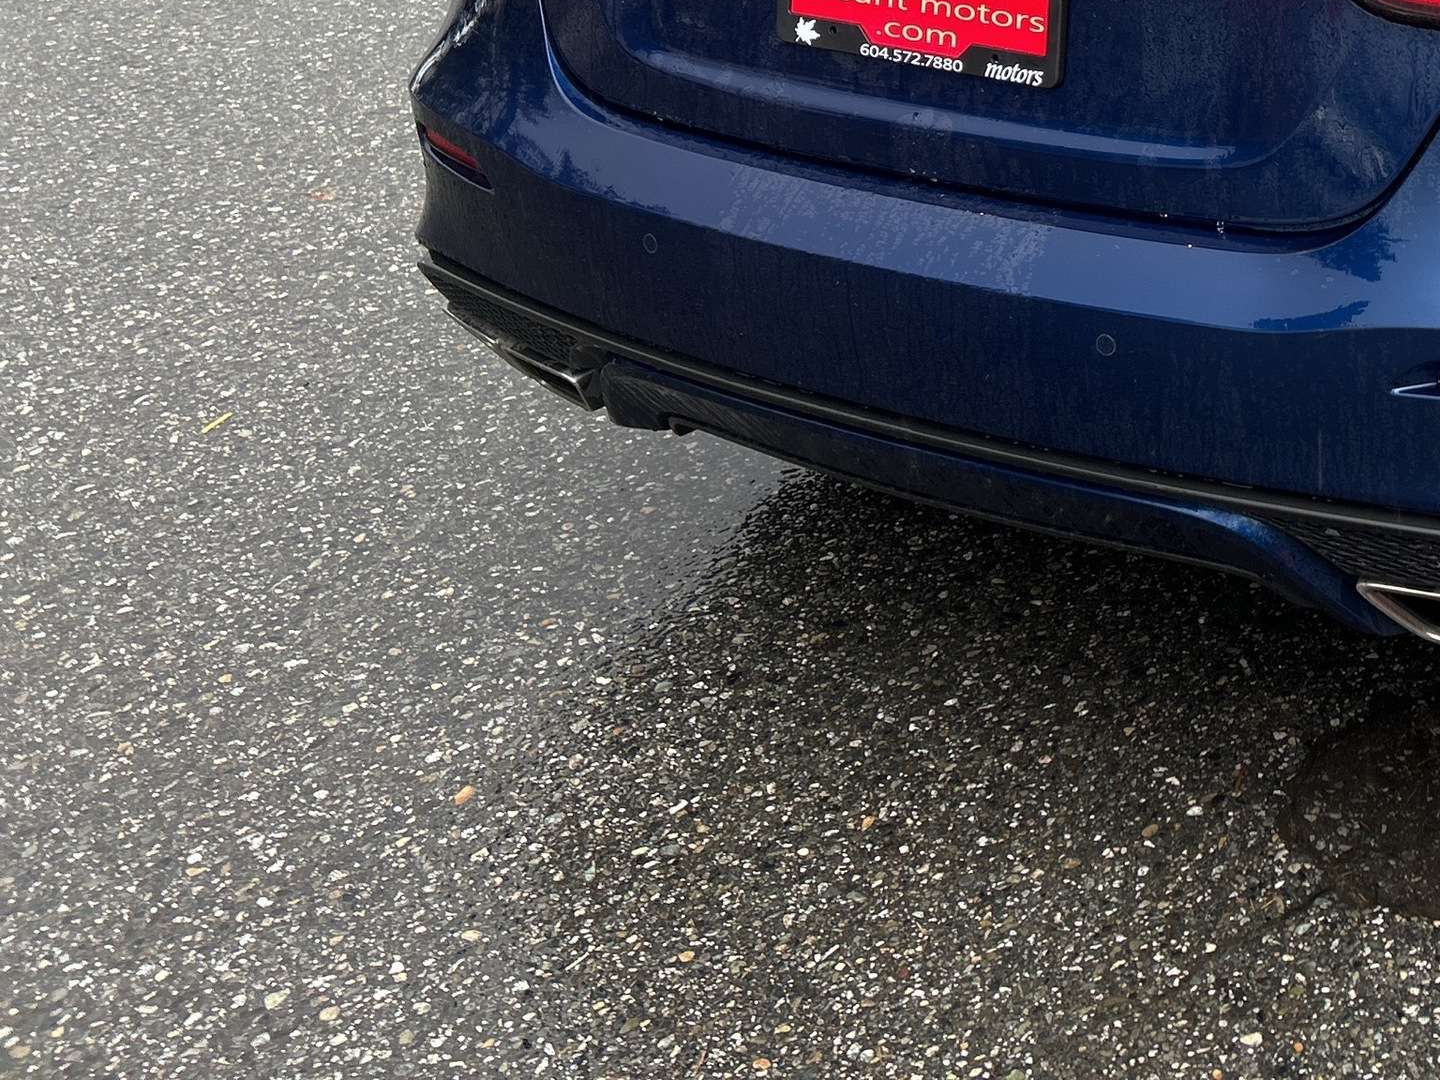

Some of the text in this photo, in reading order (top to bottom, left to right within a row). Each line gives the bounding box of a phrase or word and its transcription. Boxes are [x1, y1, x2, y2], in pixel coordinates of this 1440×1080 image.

[876, 21, 957, 48] .com
[859, 43, 964, 73] 604.572.7880
[984, 60, 1045, 88] motors
